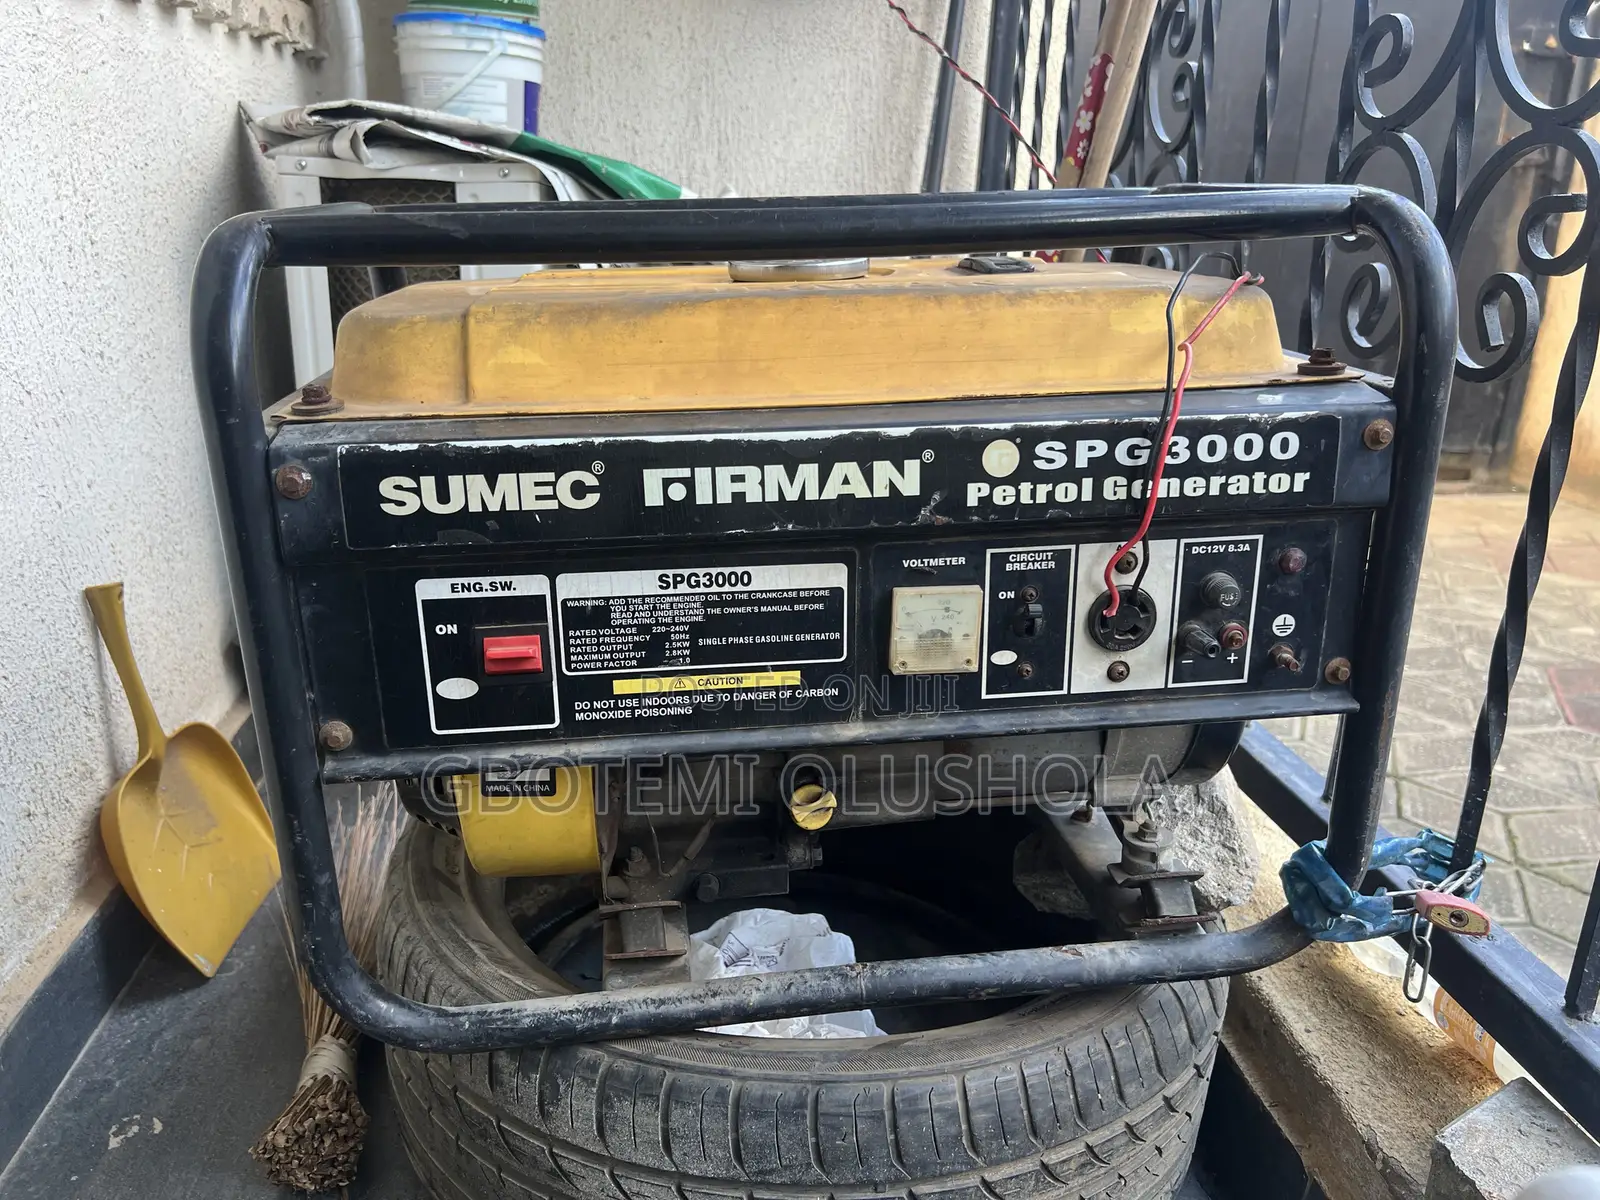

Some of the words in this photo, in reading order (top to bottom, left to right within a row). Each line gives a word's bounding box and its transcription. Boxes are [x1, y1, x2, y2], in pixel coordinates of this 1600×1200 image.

[1032, 431, 1300, 470] SPG3000
[966, 476, 1092, 508] Petrol
[1102, 470, 1311, 501] Generator
[1191, 545, 1226, 555] DC12V
[1227, 543, 1251, 553] 8.3A
[902, 556, 966, 568] VOLTMETER
[1008, 552, 1054, 562] CIRCUIT
[1005, 561, 1056, 572] BREAKER
[657, 570, 752, 591] SPG3000
[450, 580, 517, 594] ENG.SW.
[566, 599, 607, 608] WARNING:
[608, 598, 626, 606] ADD
[627, 597, 643, 605] THE
[644, 595, 706, 604] RECOMMENDED
[734, 592, 749, 600] THE
[750, 591, 798, 600] CRANKCASE
[800, 589, 830, 598] BEFORE
[998, 590, 1015, 600] ON
[610, 605, 627, 613] YOU
[628, 603, 654, 612] START
[673, 601, 704, 610] ENGINE.
[610, 611, 633, 620] READ
[652, 608, 705, 618] UNDERSTAND
[723, 606, 759, 614] OWNER'S
[760, 605, 793, 613] MANUAL
[794, 603, 825, 611] BEFORE
[610, 617, 656, 626] OPERATING
[674, 615, 706, 624] ENGINE.
[435, 624, 458, 635] ON
[568, 629, 597, 637] RATED
[599, 627, 638, 636] VOLTAGE
[569, 637, 598, 645] RATED
[600, 635, 651, 644] FREQUENCY
[670, 633, 690, 641] 50Hz
[698, 637, 727, 646] SINGLE
[728, 635, 754, 645] PHASE
[755, 634, 794, 643] GASOLINE
[795, 632, 841, 642] GENERATOR
[569, 645, 598, 654] RATED
[599, 643, 634, 652] OUTPUT
[664, 641, 690, 649] 2.5KW
[570, 653, 611, 662] MAXIMUM
[612, 651, 647, 660] OUTPUT
[665, 649, 691, 657] 2.8KW
[571, 661, 602, 670] POWER
[603, 659, 638, 668] FACTOR
[697, 676, 744, 687] CAUTION
[574, 701, 591, 710] DO
[593, 699, 616, 709] NOT
[618, 698, 640, 708] USE
[642, 696, 690, 707] INDOORS
[692, 694, 714, 704] DUE
[717, 693, 731, 702] TO
[733, 691, 777, 702] DANGER
[778, 689, 793, 699] OF
[795, 687, 839, 698] CARBON
[575, 709, 632, 721] MONOXIDE
[634, 706, 693, 718] POISONING
[485, 784, 511, 792] MADE
[512, 784, 522, 792] IN
[523, 784, 551, 792] CHINA
